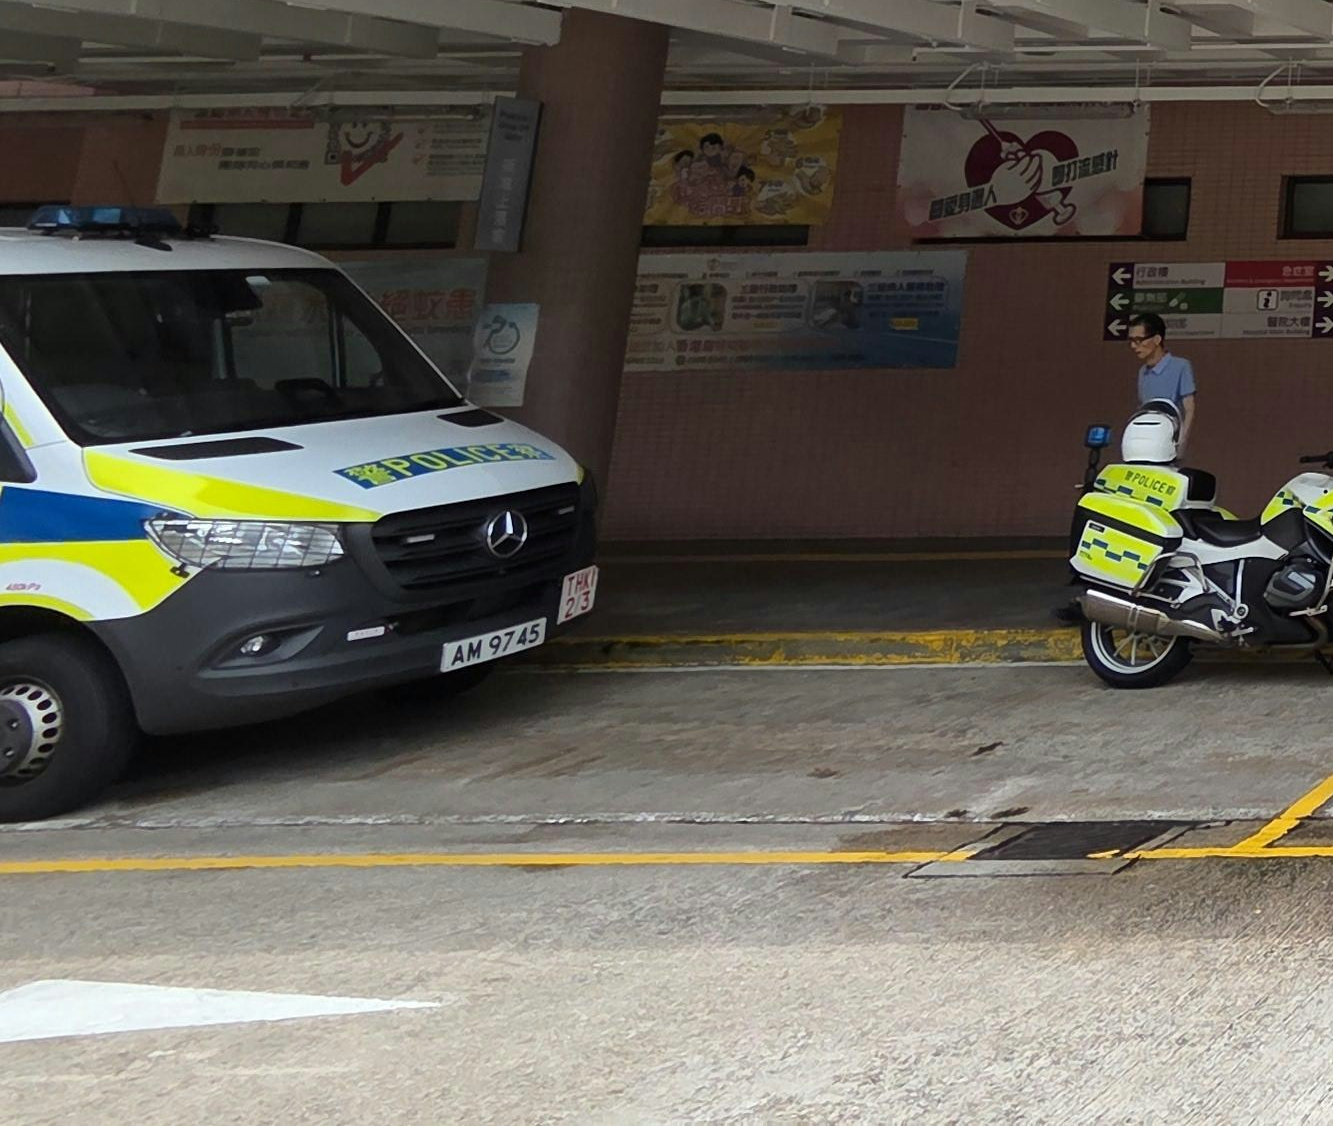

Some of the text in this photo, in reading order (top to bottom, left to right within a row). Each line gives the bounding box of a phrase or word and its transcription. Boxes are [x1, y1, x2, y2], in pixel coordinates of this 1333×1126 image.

[387, 445, 518, 476] POLICE
[1132, 473, 1167, 493] POLICE
[451, 623, 541, 667] AM 9745
